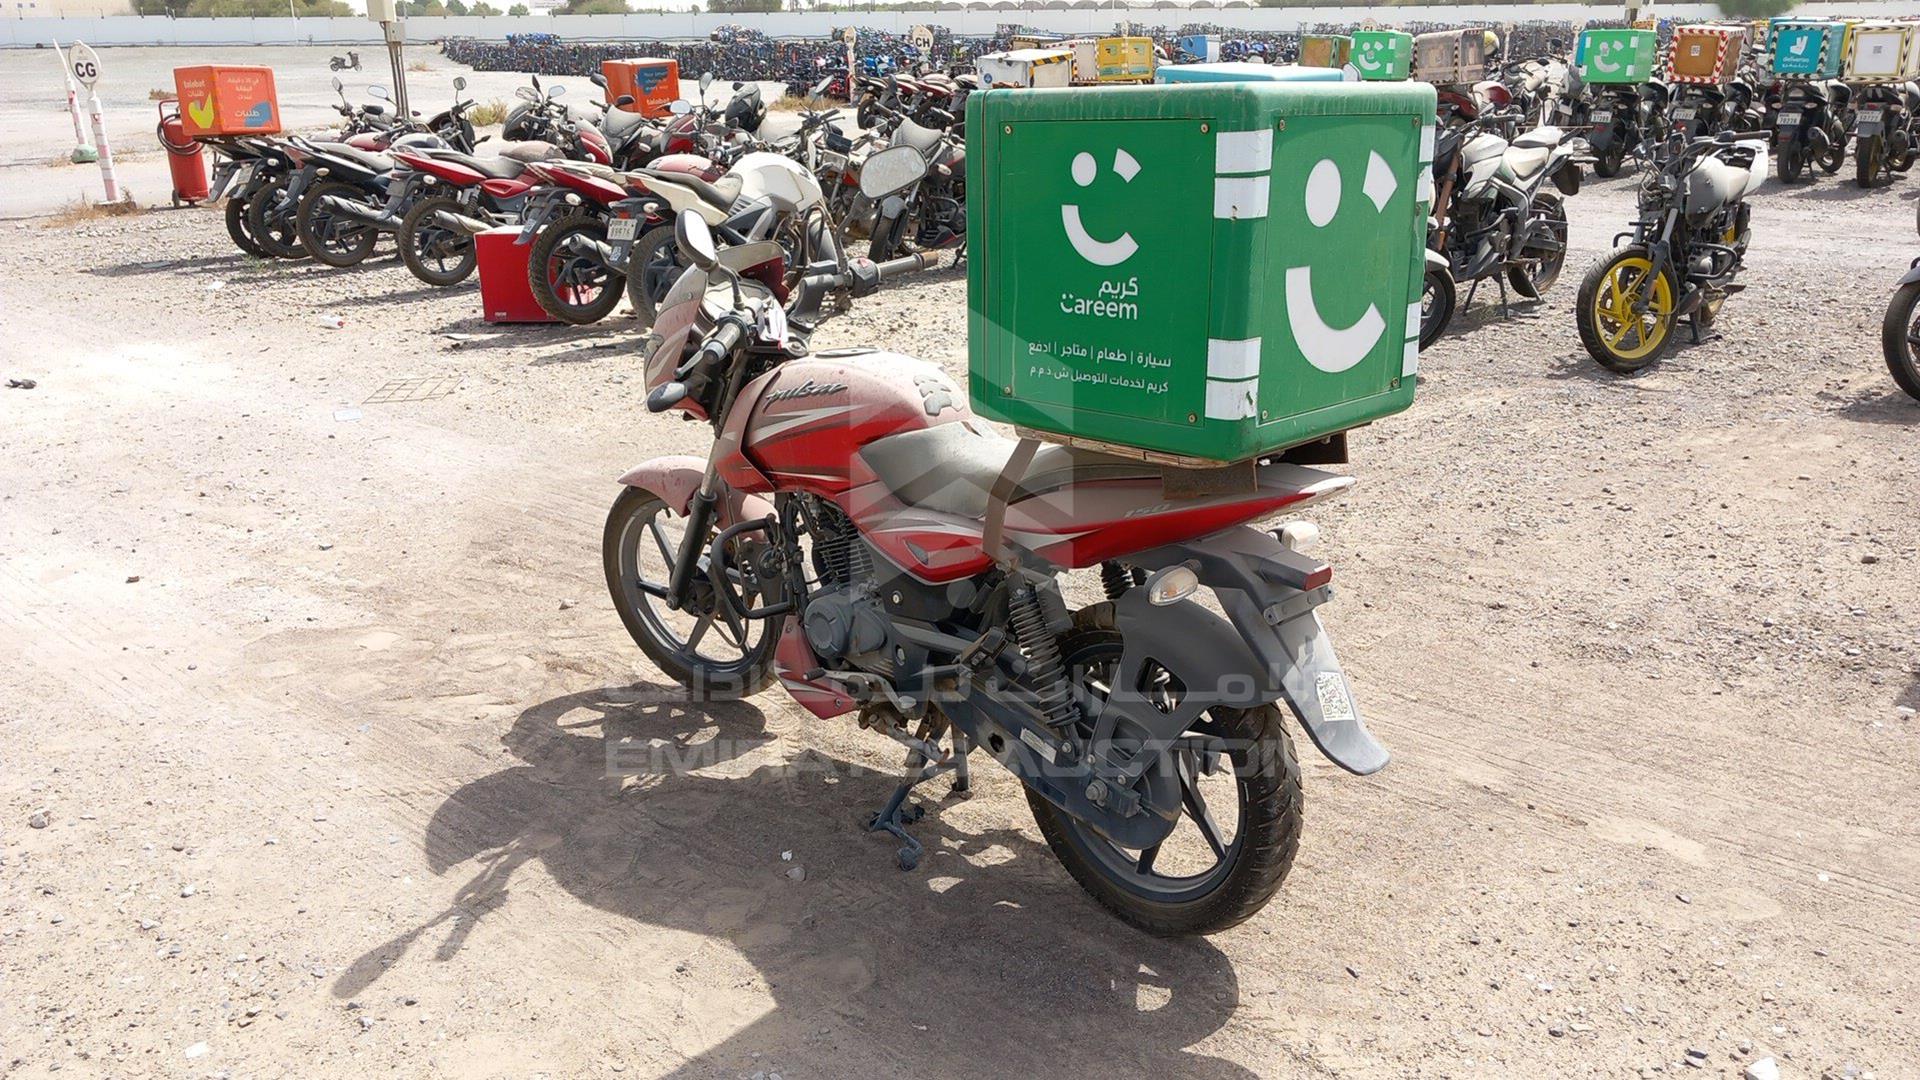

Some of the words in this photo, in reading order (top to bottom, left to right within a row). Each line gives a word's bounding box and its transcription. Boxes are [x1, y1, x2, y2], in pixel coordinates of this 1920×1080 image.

[915, 38, 930, 47] CH
[75, 62, 96, 77] CG
[1098, 277, 1138, 299] كريم
[1060, 294, 1138, 320] Careem
[1028, 341, 1051, 355] ادفع
[1060, 343, 1087, 357] متاجر
[1096, 347, 1127, 364] طعام
[1136, 351, 1171, 368] سيارة
[1070, 369, 1108, 385] التوصيل
[1109, 375, 1145, 389] لخدمات
[1146, 381, 1169, 394] كريم
[762, 379, 849, 414] pulsar
